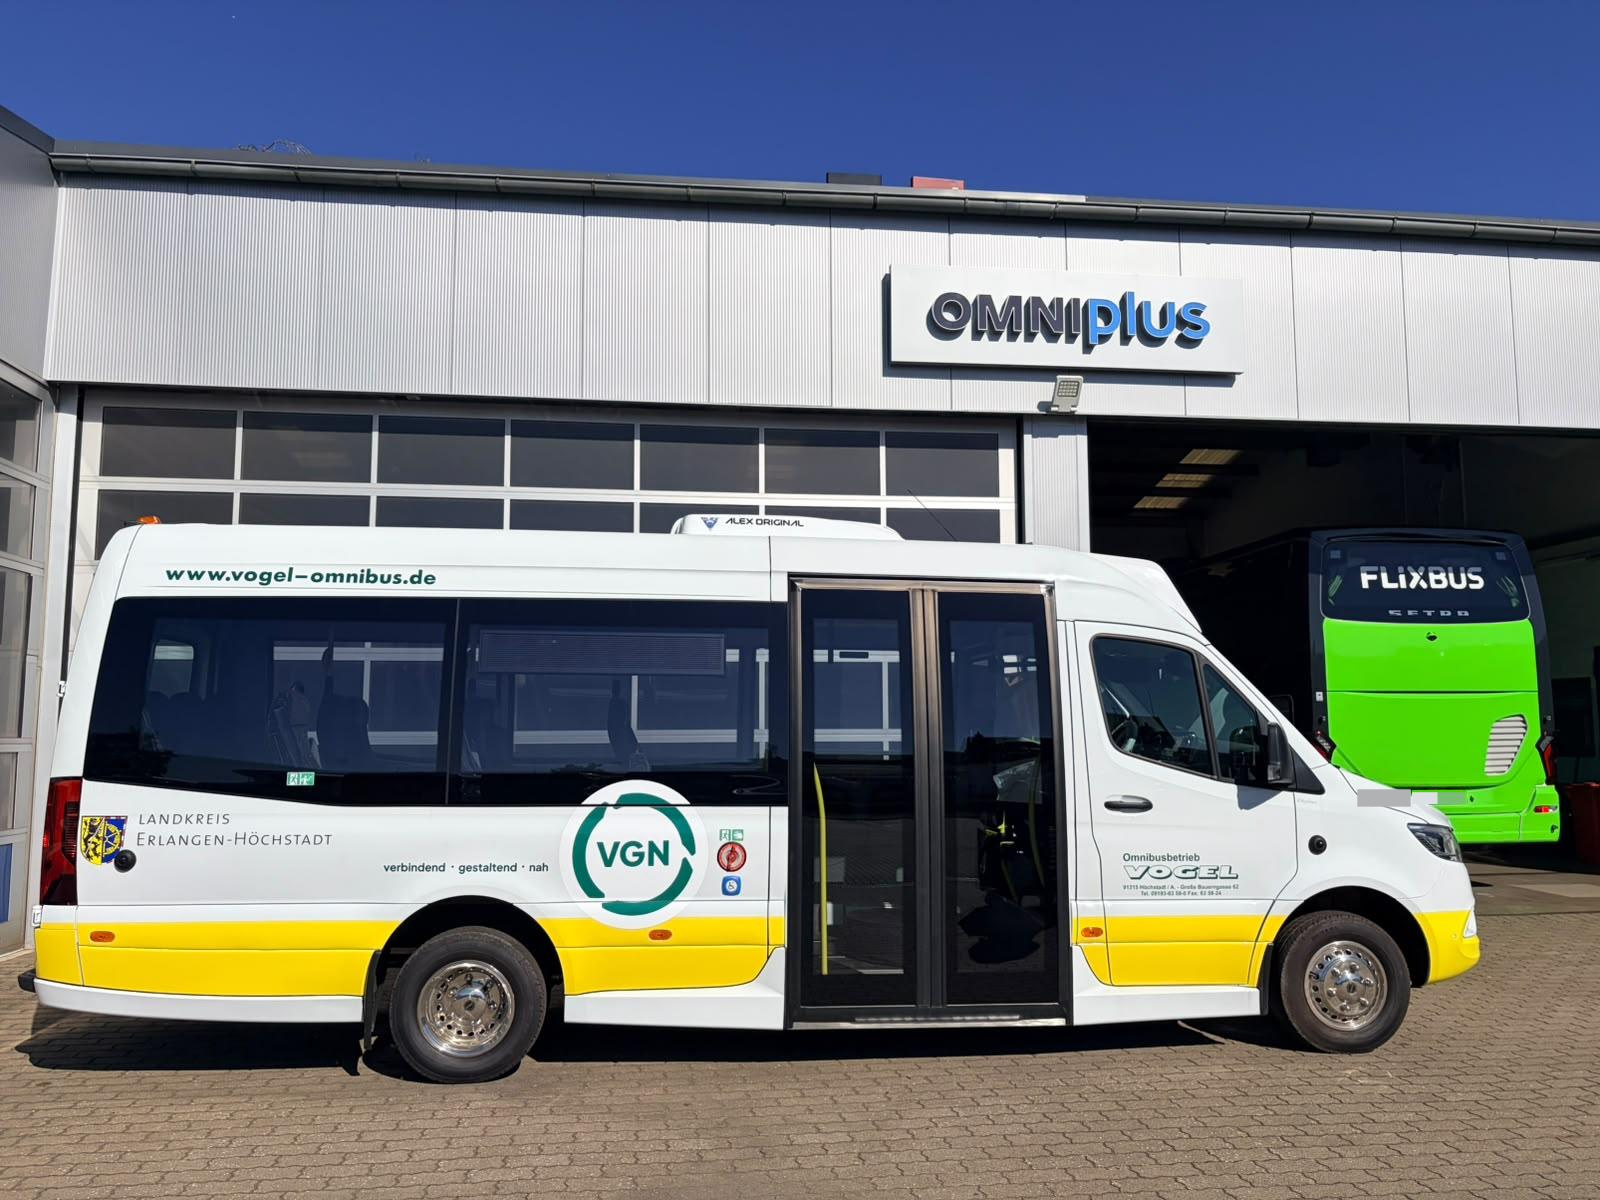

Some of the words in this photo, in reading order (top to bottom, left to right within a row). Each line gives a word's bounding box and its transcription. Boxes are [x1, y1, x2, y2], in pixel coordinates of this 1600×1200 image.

[929, 291, 1211, 347] OMNIplus
[755, 518, 804, 527] ORIGINAL
[166, 567, 437, 586] www.vogel-omnibus.de
[138, 813, 231, 825] LANDKREIS
[596, 840, 670, 868] VGN
[1122, 852, 1201, 862] Omnibusbetrieb
[383, 862, 446, 873] verbindend
[458, 862, 518, 875] gestaltend
[529, 862, 549, 873] nah
[1123, 864, 1239, 880] VOGEL
